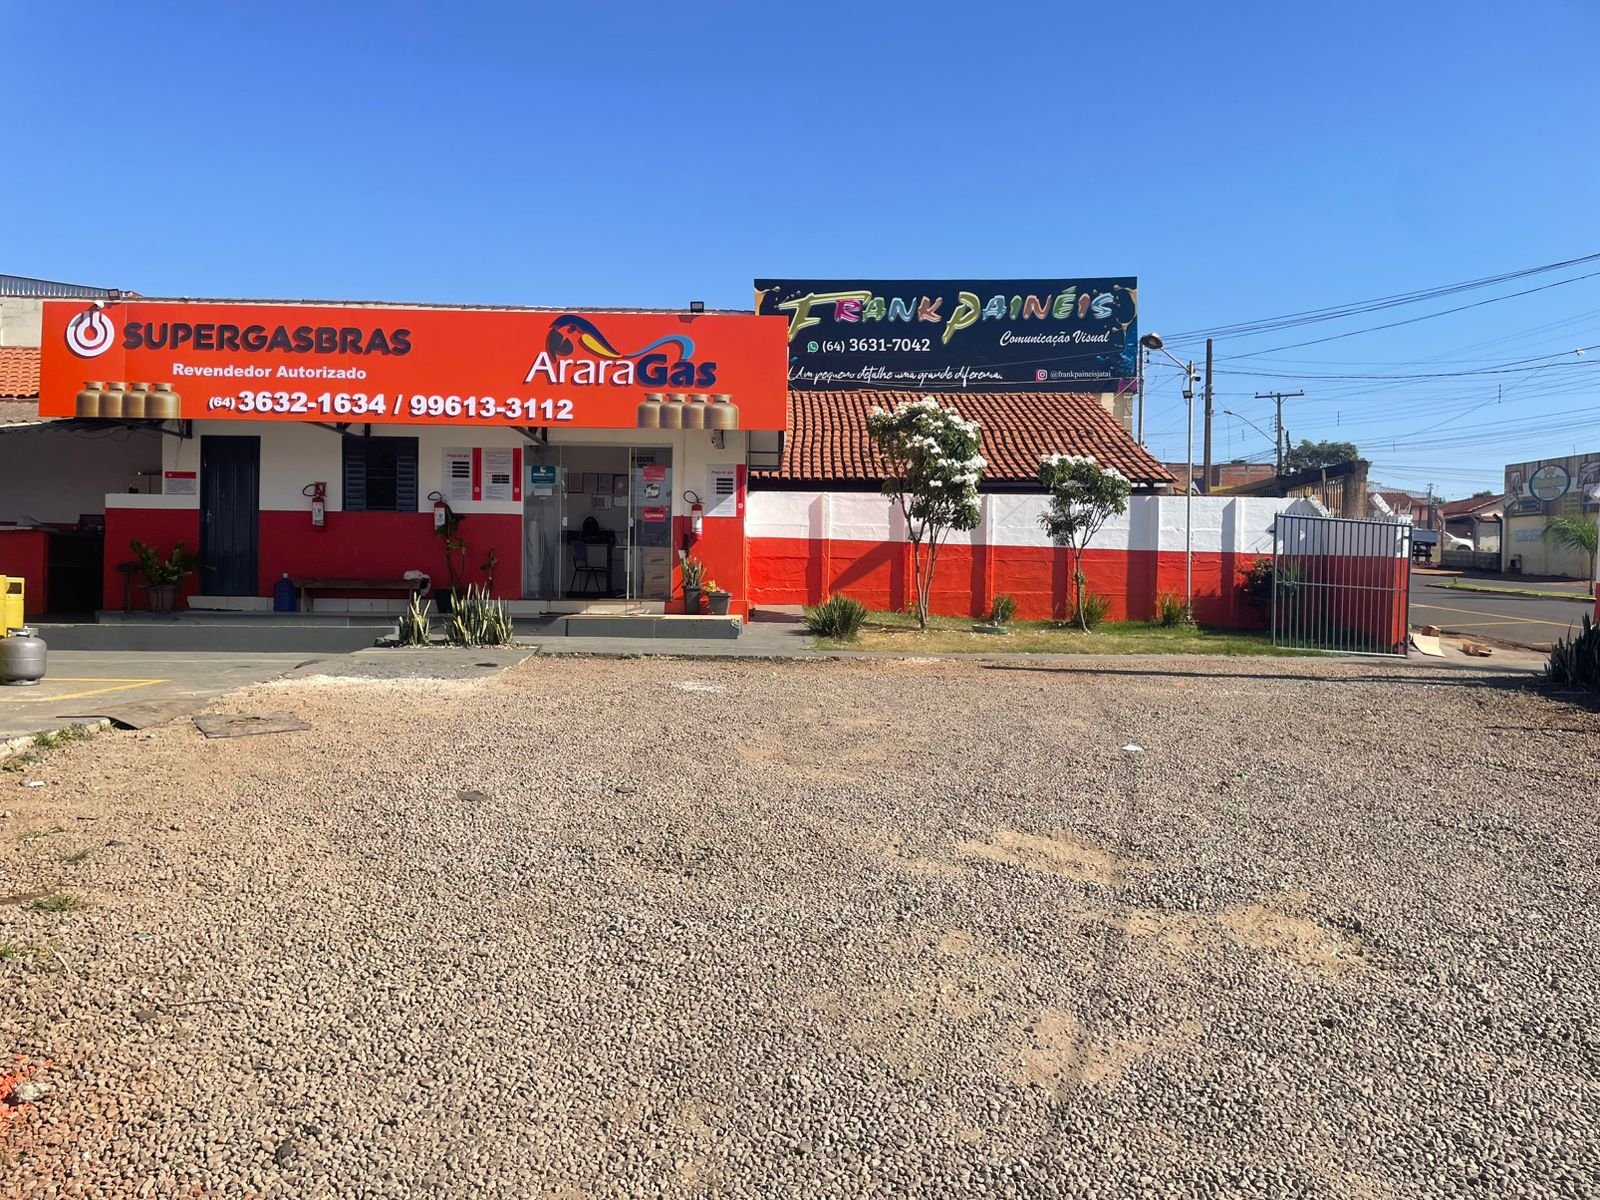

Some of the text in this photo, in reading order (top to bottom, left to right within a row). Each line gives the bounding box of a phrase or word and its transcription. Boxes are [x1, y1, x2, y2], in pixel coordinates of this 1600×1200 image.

[778, 285, 1115, 344] FRANK PAINÉIS
[122, 322, 412, 355] SUPERGASBRAS
[822, 338, 931, 353] (64) 3631-7042
[1000, 329, 1111, 347] Comunicação Visual
[172, 363, 367, 380] Revendedor Autorizado
[524, 351, 718, 387] AraraGas
[813, 371, 855, 385] pequeno
[856, 365, 893, 384] detalhe
[894, 372, 917, 380] uma
[917, 365, 953, 387] grande
[208, 391, 574, 420] (64) 3632-1634 / 99613-3112
